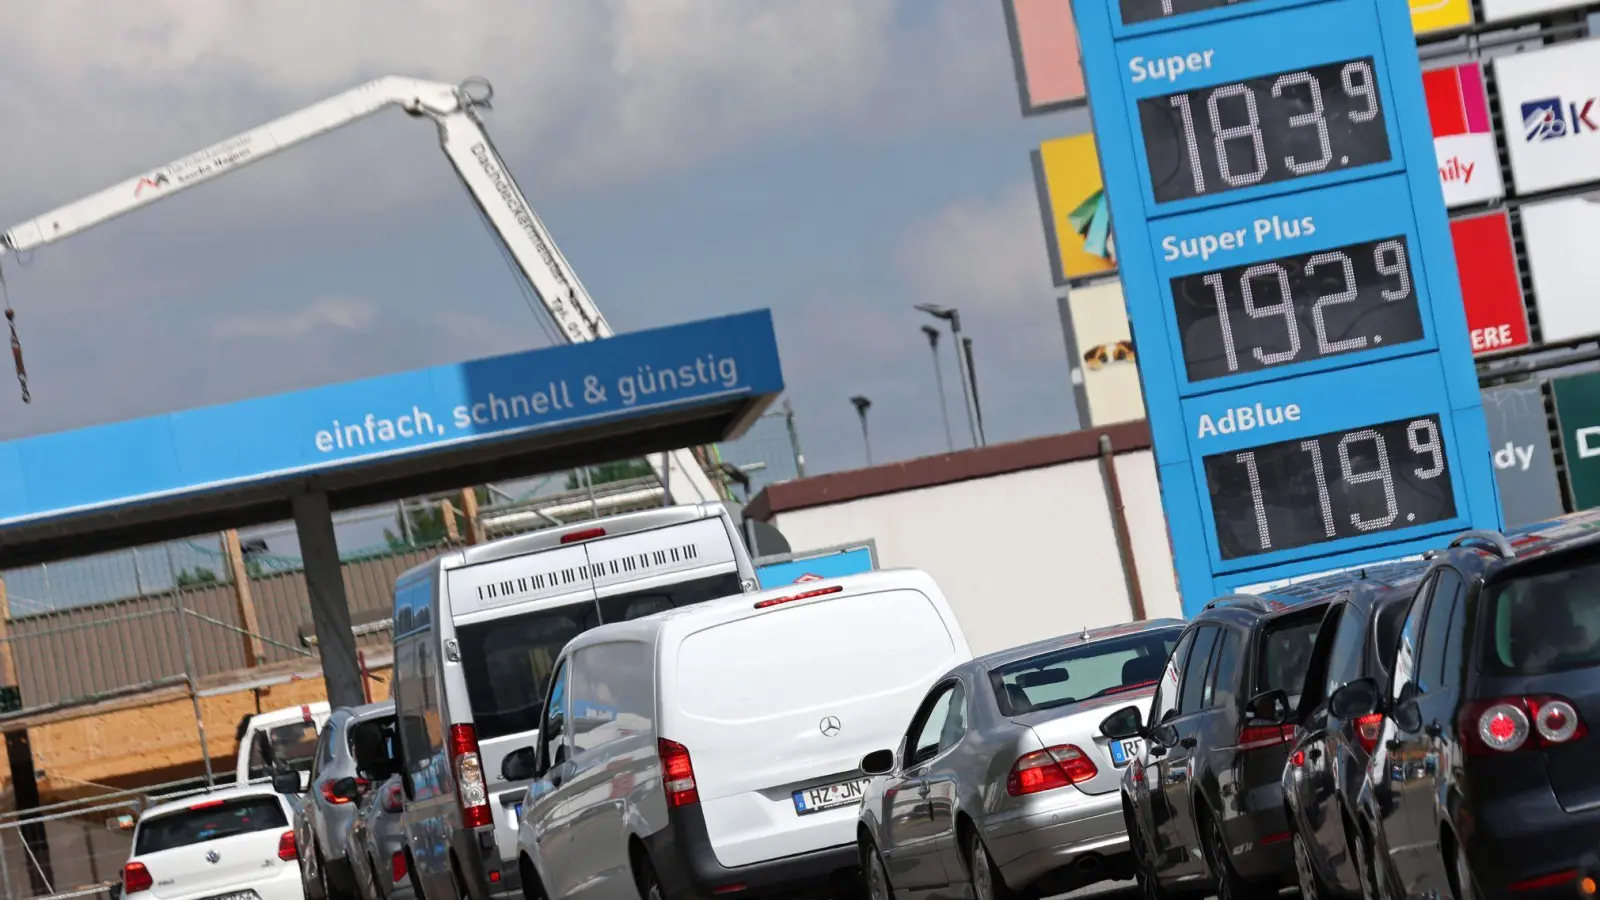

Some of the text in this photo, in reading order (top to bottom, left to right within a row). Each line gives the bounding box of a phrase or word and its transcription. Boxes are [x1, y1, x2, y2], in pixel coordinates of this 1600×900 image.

[1129, 48, 1215, 83] Super
[1161, 215, 1316, 262] Super Plus
[1470, 323, 1513, 350] ERE
[315, 353, 738, 452] einfach, schnell & günstig
[1197, 402, 1301, 439] AdBlue
[1494, 441, 1535, 472] dy
[809, 787, 832, 806] HZ
[841, 779, 861, 799] JN
